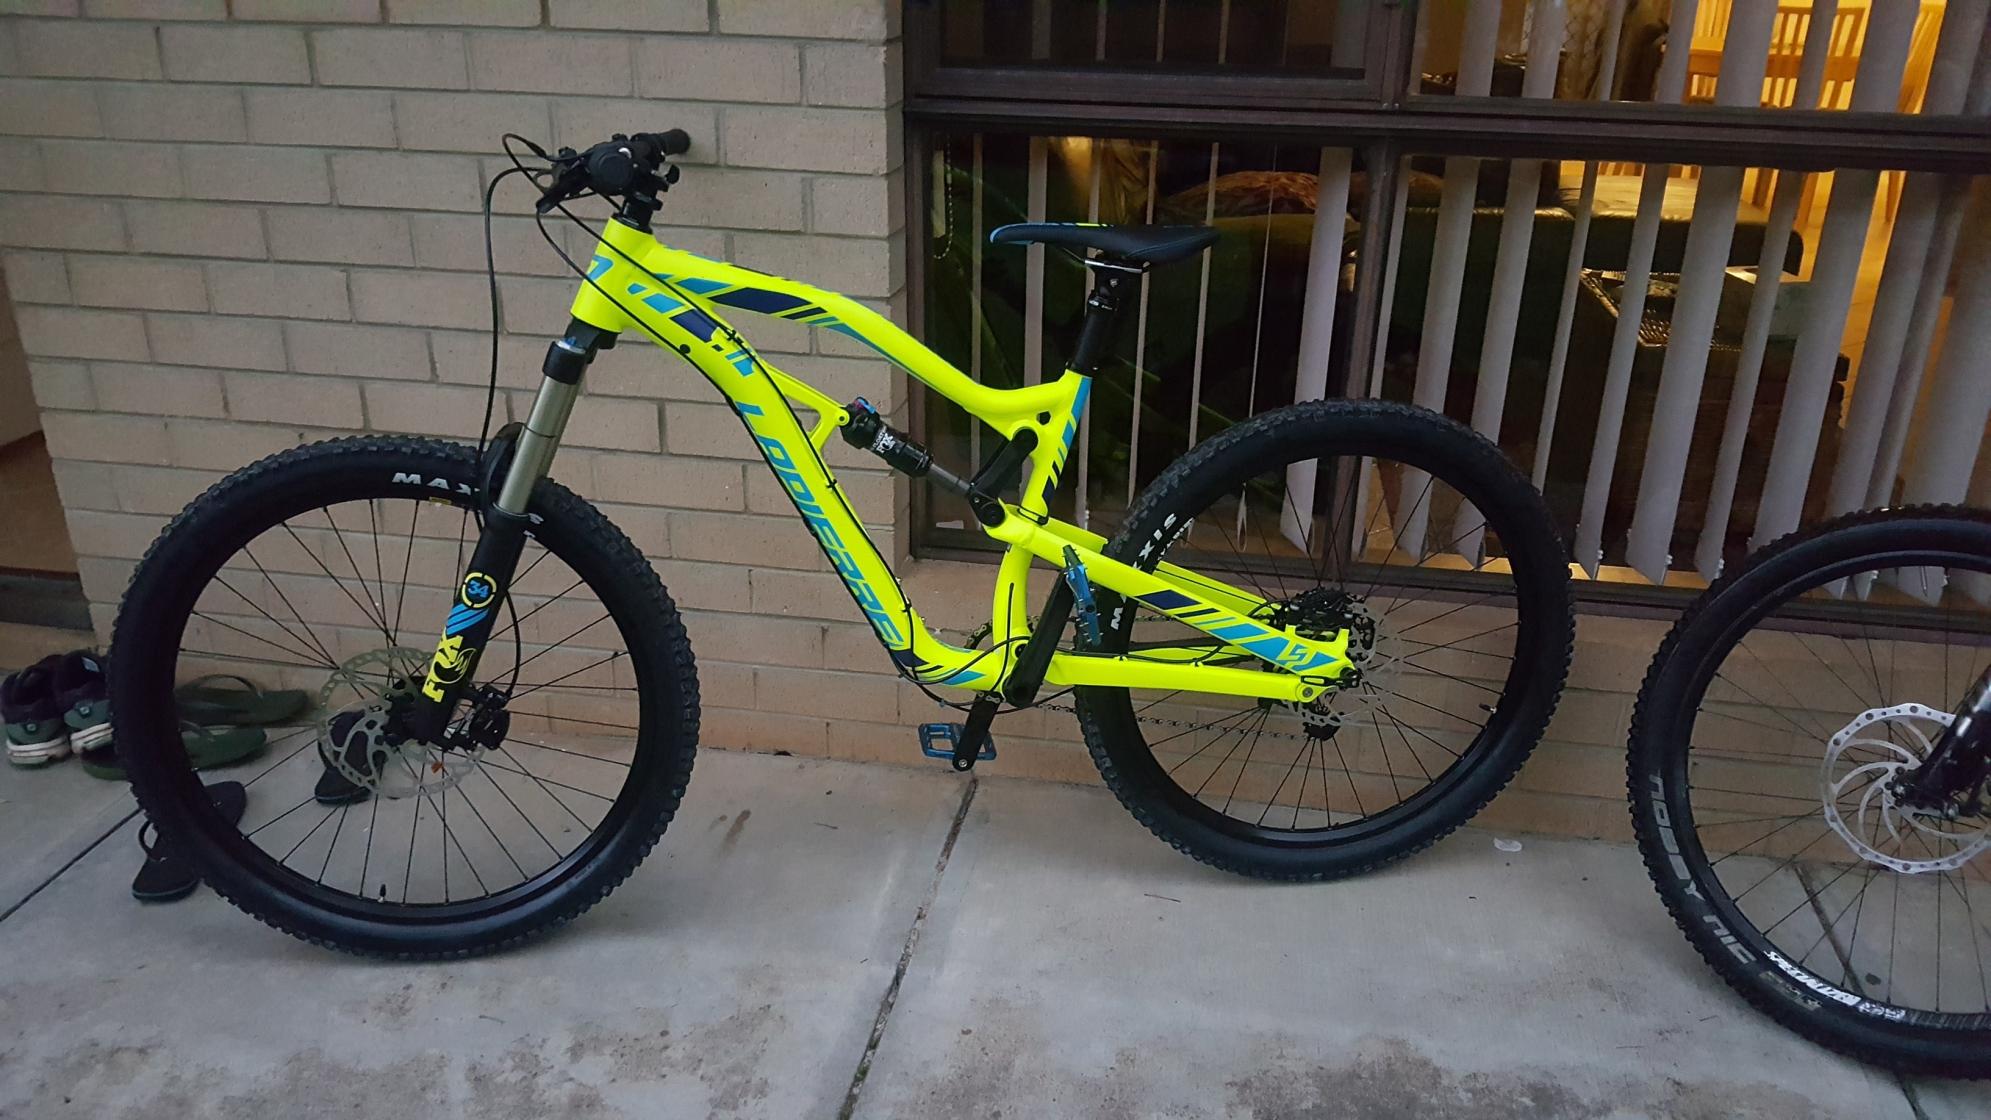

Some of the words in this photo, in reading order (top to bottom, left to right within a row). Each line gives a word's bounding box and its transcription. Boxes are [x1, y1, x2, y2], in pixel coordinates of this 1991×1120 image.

[468, 580, 489, 598] 34
[1110, 513, 1177, 630] MXIS
[422, 628, 476, 703] FOX
